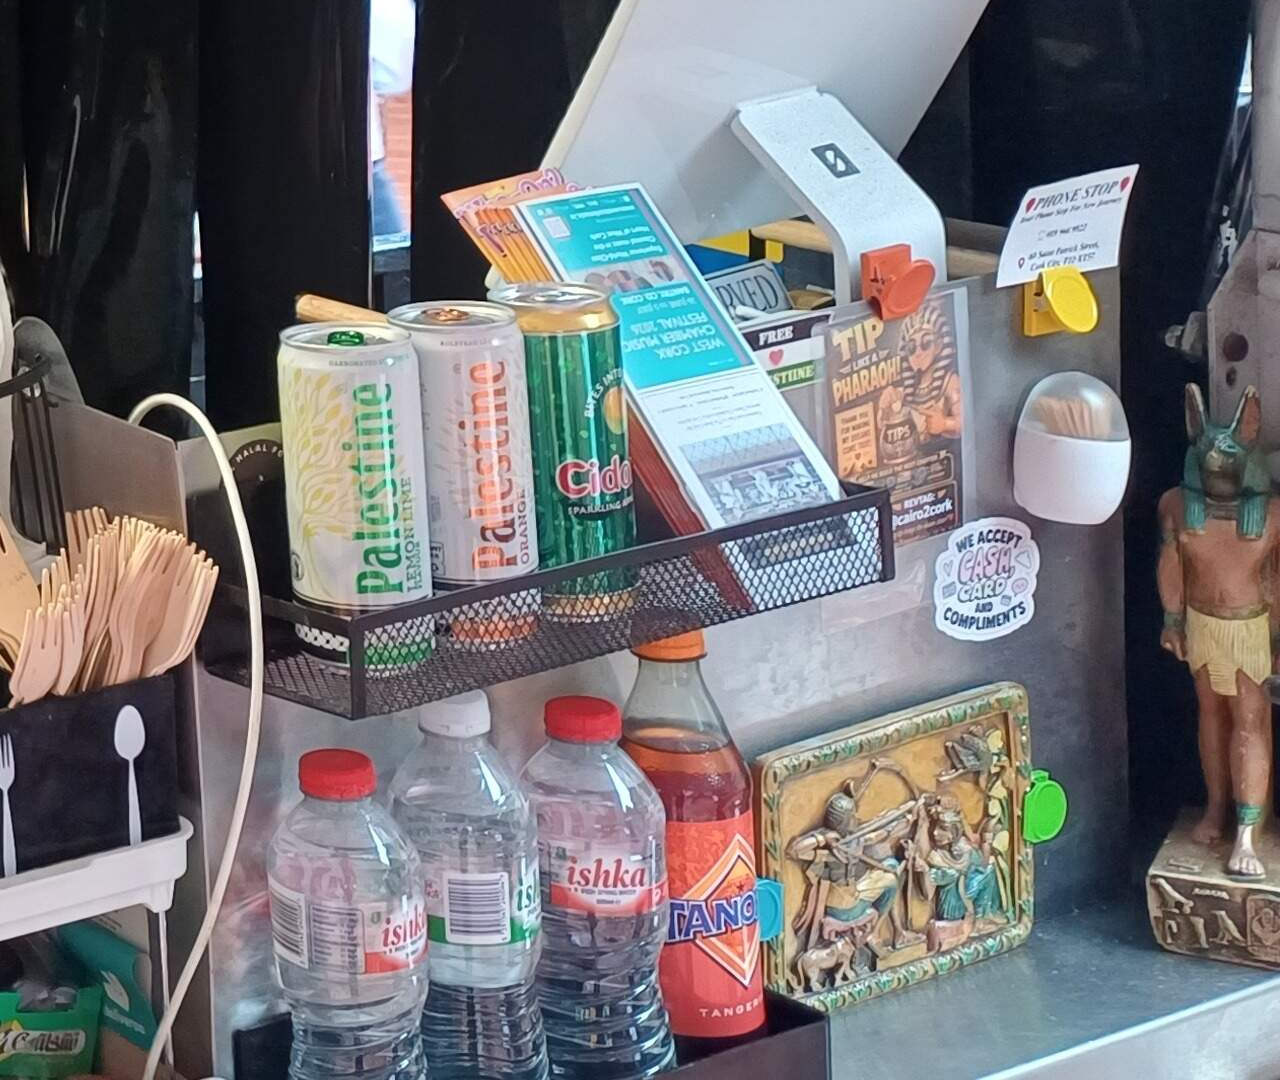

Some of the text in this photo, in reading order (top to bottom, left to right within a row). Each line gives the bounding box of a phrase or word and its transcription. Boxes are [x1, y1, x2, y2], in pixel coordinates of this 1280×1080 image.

[1034, 181, 1119, 211] PHONE STOP
[716, 275, 779, 320] RVED
[657, 312, 708, 329] FESTIVAL
[758, 326, 794, 345] FREE
[654, 338, 725, 359] WEST CORK
[831, 316, 884, 362] TIP
[772, 365, 815, 385] STINE
[853, 353, 879, 370] LIKE A
[832, 356, 902, 407] PHARAOH!
[886, 425, 912, 441] TIPS
[235, 443, 267, 463] HALAL
[459, 361, 518, 571] Palestine
[342, 383, 404, 594] Palestine
[555, 454, 633, 499] Cido
[401, 477, 416, 520] LIME
[517, 489, 530, 564] ORANGE
[956, 529, 1023, 553] WE ACCEPT
[404, 521, 422, 592] LEMON
[957, 545, 1016, 585] CASH,
[957, 576, 1008, 603] CARD
[943, 601, 1026, 630] COMPLIMENTS
[975, 601, 994, 613] AND
[567, 855, 647, 889] ishka
[669, 890, 757, 943] TANG
[699, 997, 762, 1019] TANGER
